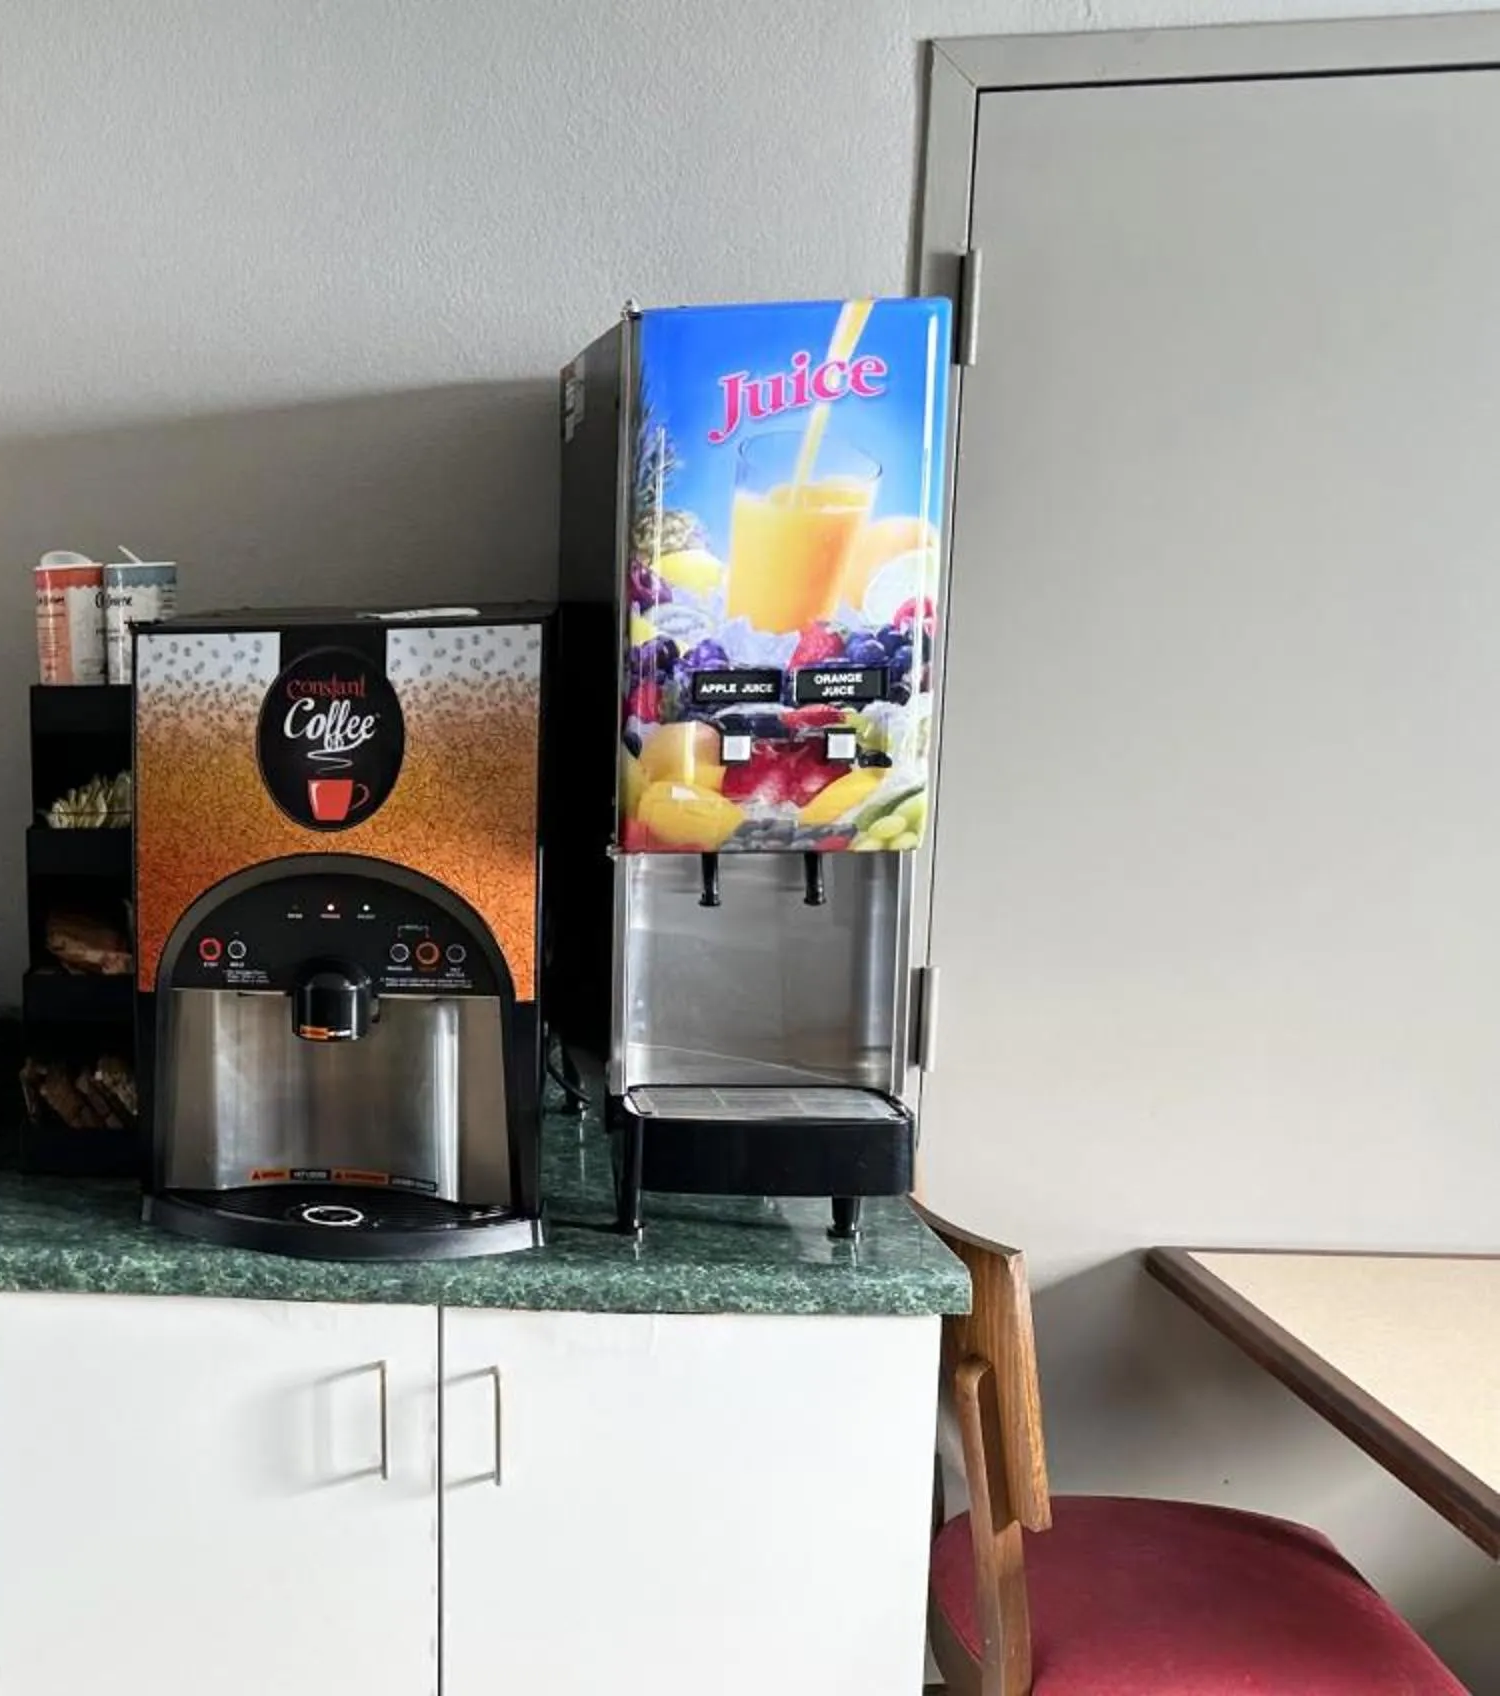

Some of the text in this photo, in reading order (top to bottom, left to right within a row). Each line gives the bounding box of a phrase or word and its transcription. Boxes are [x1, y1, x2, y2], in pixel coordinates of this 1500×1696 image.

[708, 351, 888, 444] Juice
[813, 672, 864, 685] ORANGE
[700, 682, 775, 694] APPLE JUICE
[821, 685, 856, 697] JUICE
[283, 697, 376, 751] Coffee
